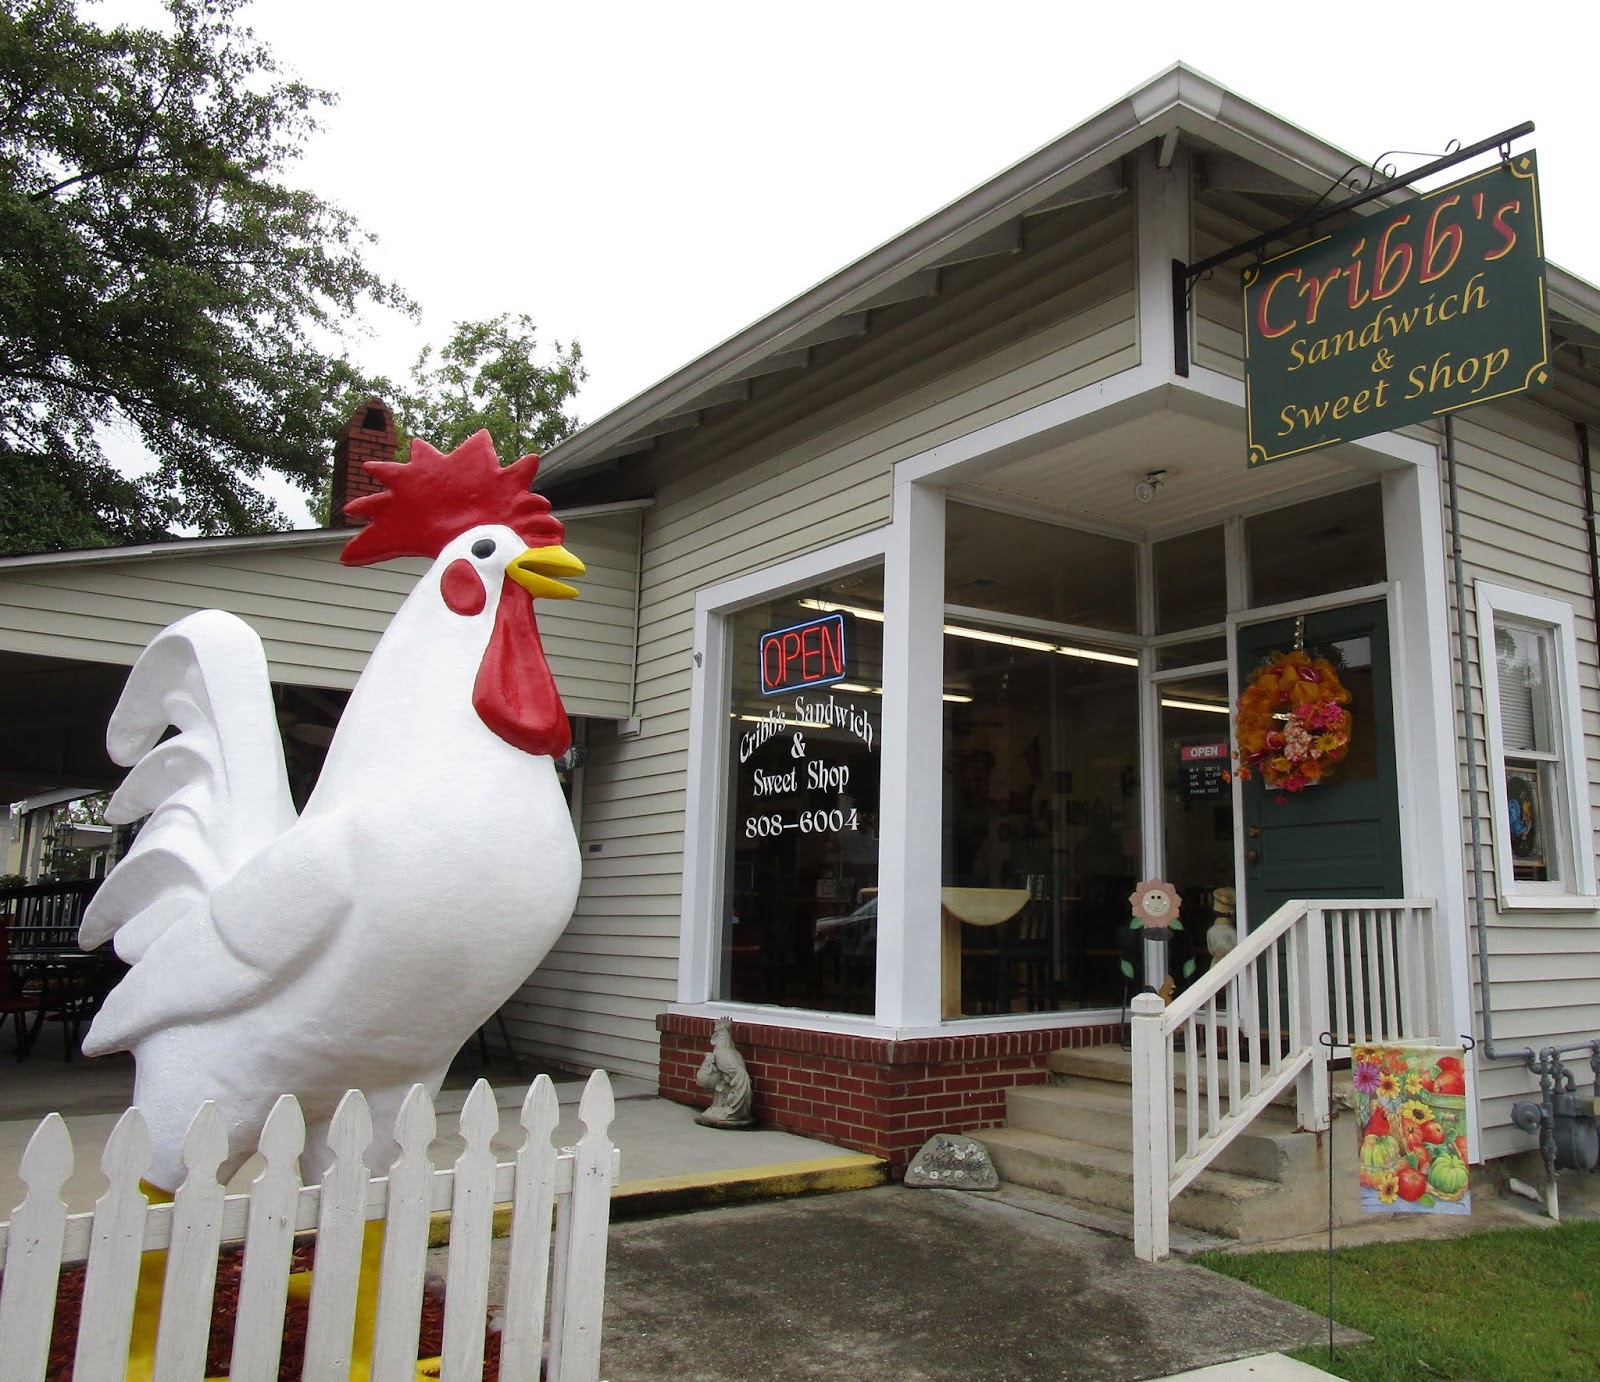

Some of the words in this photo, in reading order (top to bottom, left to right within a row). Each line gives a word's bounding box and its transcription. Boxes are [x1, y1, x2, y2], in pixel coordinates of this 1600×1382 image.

[1257, 192, 1520, 338] Cribb's
[1287, 272, 1490, 371] Sandwich
[1371, 348, 1395, 373] &
[1277, 379, 1390, 437] Sweet
[1404, 347, 1510, 399] Shop
[763, 623, 842, 687] OPEN
[739, 704, 786, 764] Cribb's
[794, 694, 874, 753] Sandwich
[790, 731, 806, 759] &
[1190, 746, 1218, 757] OPEN
[752, 766, 798, 797] Sweet
[806, 759, 850, 795] Shop
[745, 807, 860, 839] 808-6004
